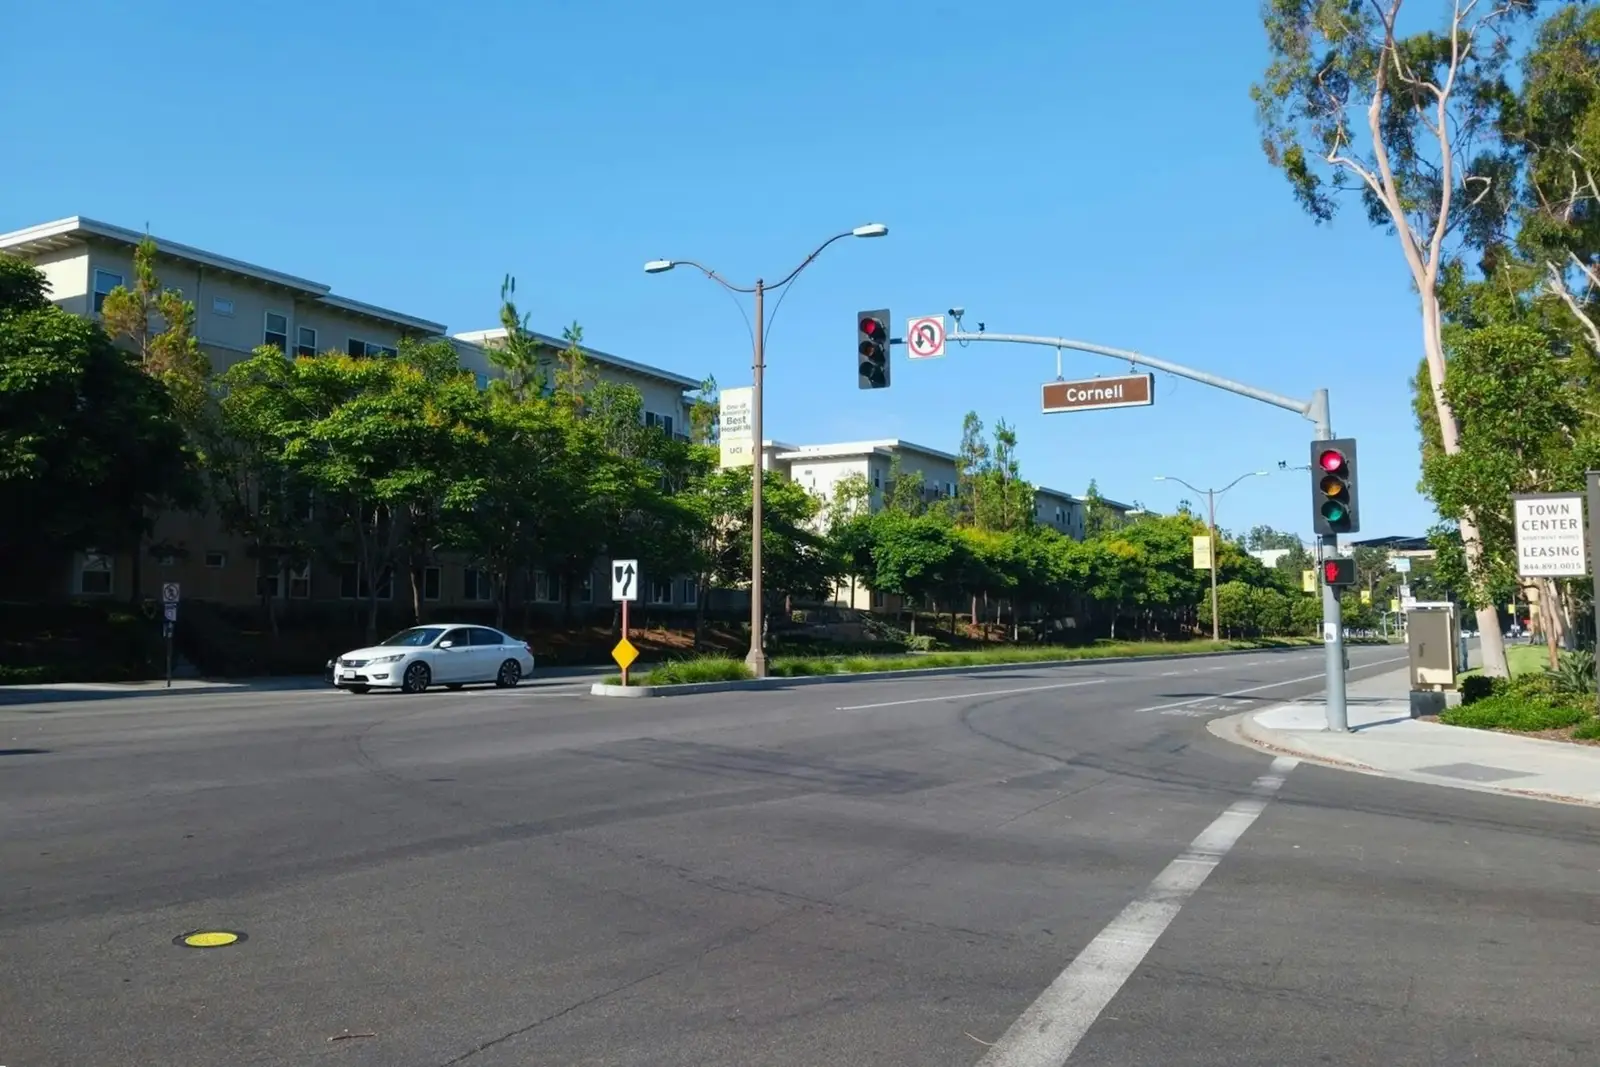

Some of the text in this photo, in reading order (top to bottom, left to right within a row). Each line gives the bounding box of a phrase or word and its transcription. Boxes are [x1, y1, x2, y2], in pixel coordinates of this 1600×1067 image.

[1066, 384, 1123, 402] Cornell
[726, 416, 747, 425] Best
[1527, 503, 1570, 516] TOWN
[1521, 518, 1578, 531] CENTER
[1523, 545, 1580, 558] LEASING
